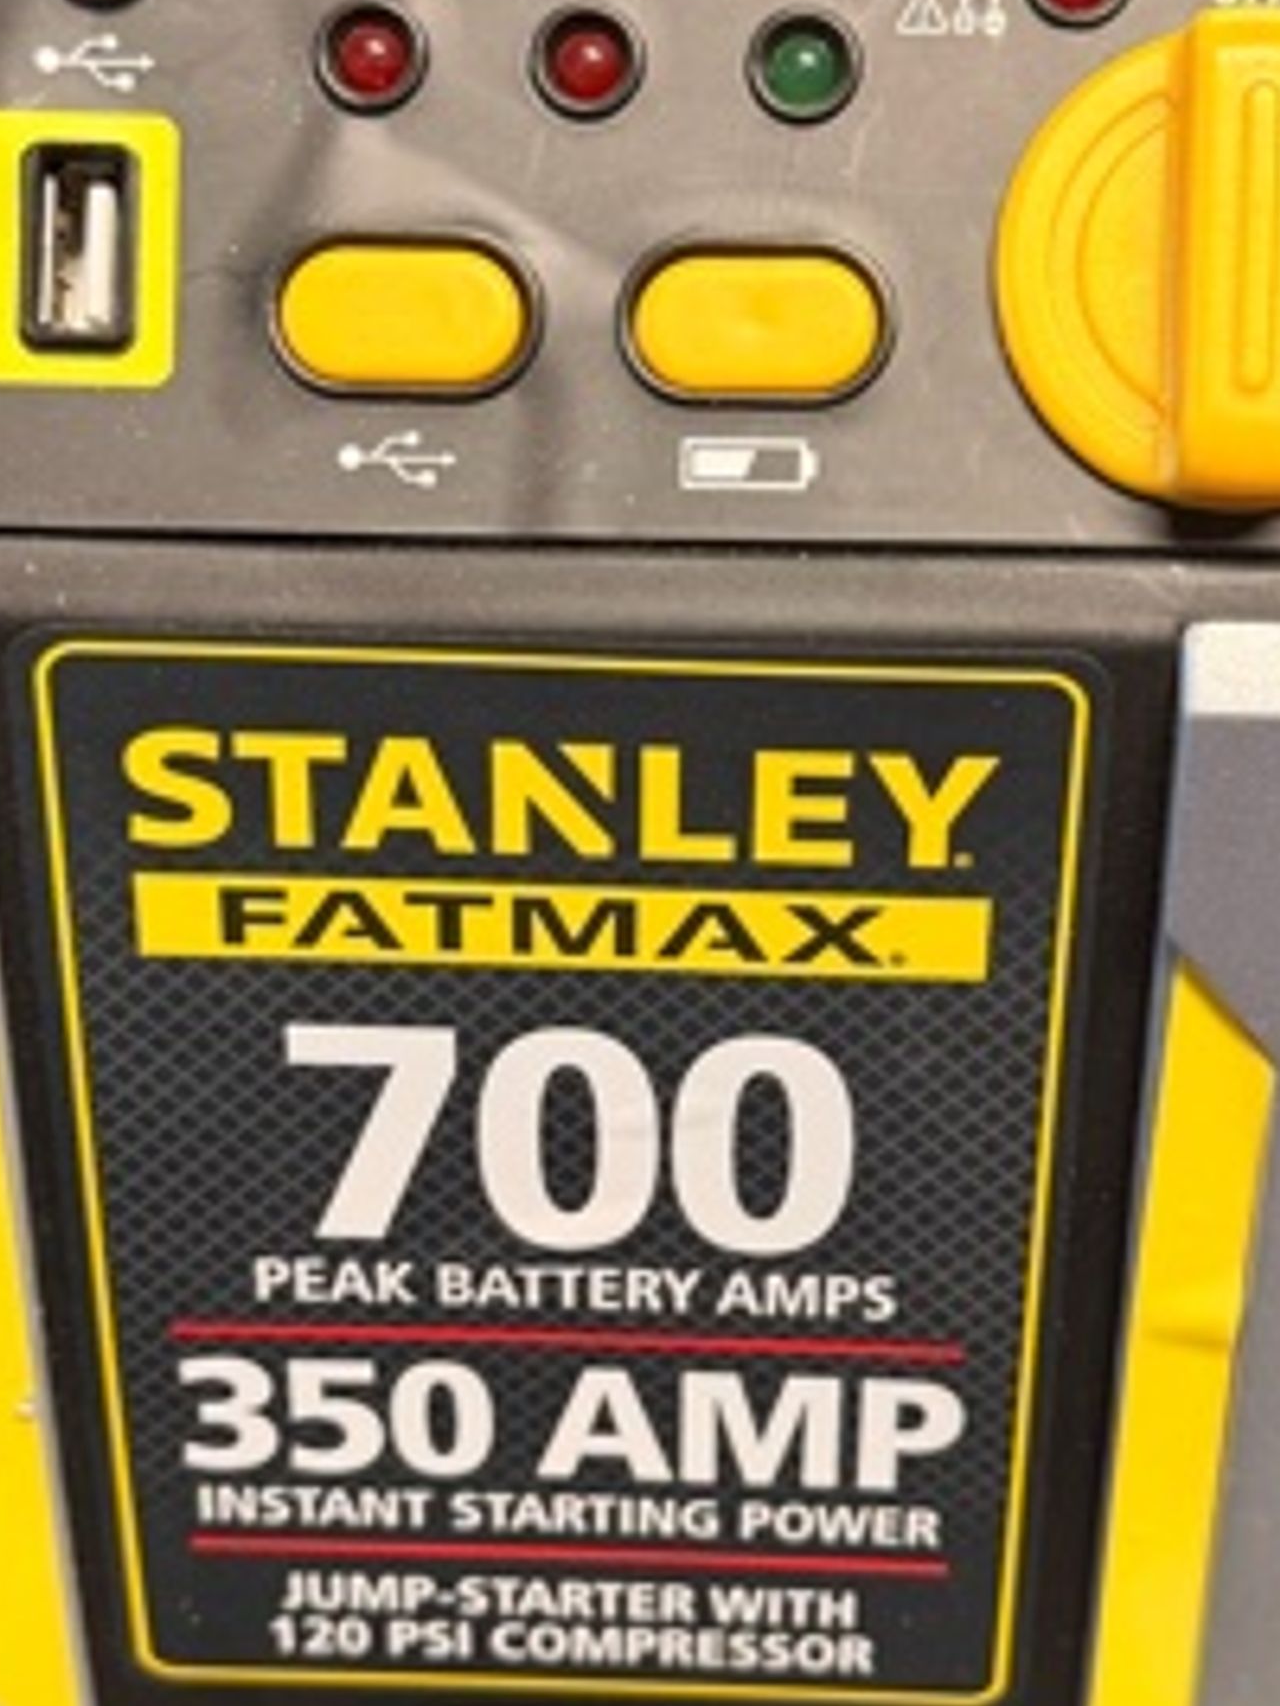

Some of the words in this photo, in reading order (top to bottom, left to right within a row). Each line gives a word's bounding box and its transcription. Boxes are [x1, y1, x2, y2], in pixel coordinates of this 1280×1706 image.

[122, 726, 1002, 869] STANLEY
[283, 1021, 856, 1257] 700
[254, 1256, 416, 1305] PEAK
[437, 1262, 700, 1313] BATTERY
[716, 1271, 898, 1324] AMPS
[178, 1355, 496, 1477] 350
[536, 1365, 968, 1493] AMP
[198, 1482, 433, 1527] INSTANT
[451, 1492, 719, 1537] STARTING
[740, 1499, 942, 1549] POWER
[282, 1571, 697, 1622] JUMP-STARTER
[710, 1586, 857, 1629] WITH
[270, 1615, 372, 1659] 120
[386, 1619, 473, 1660] PSI
[490, 1622, 873, 1675] COMPRESSOR
